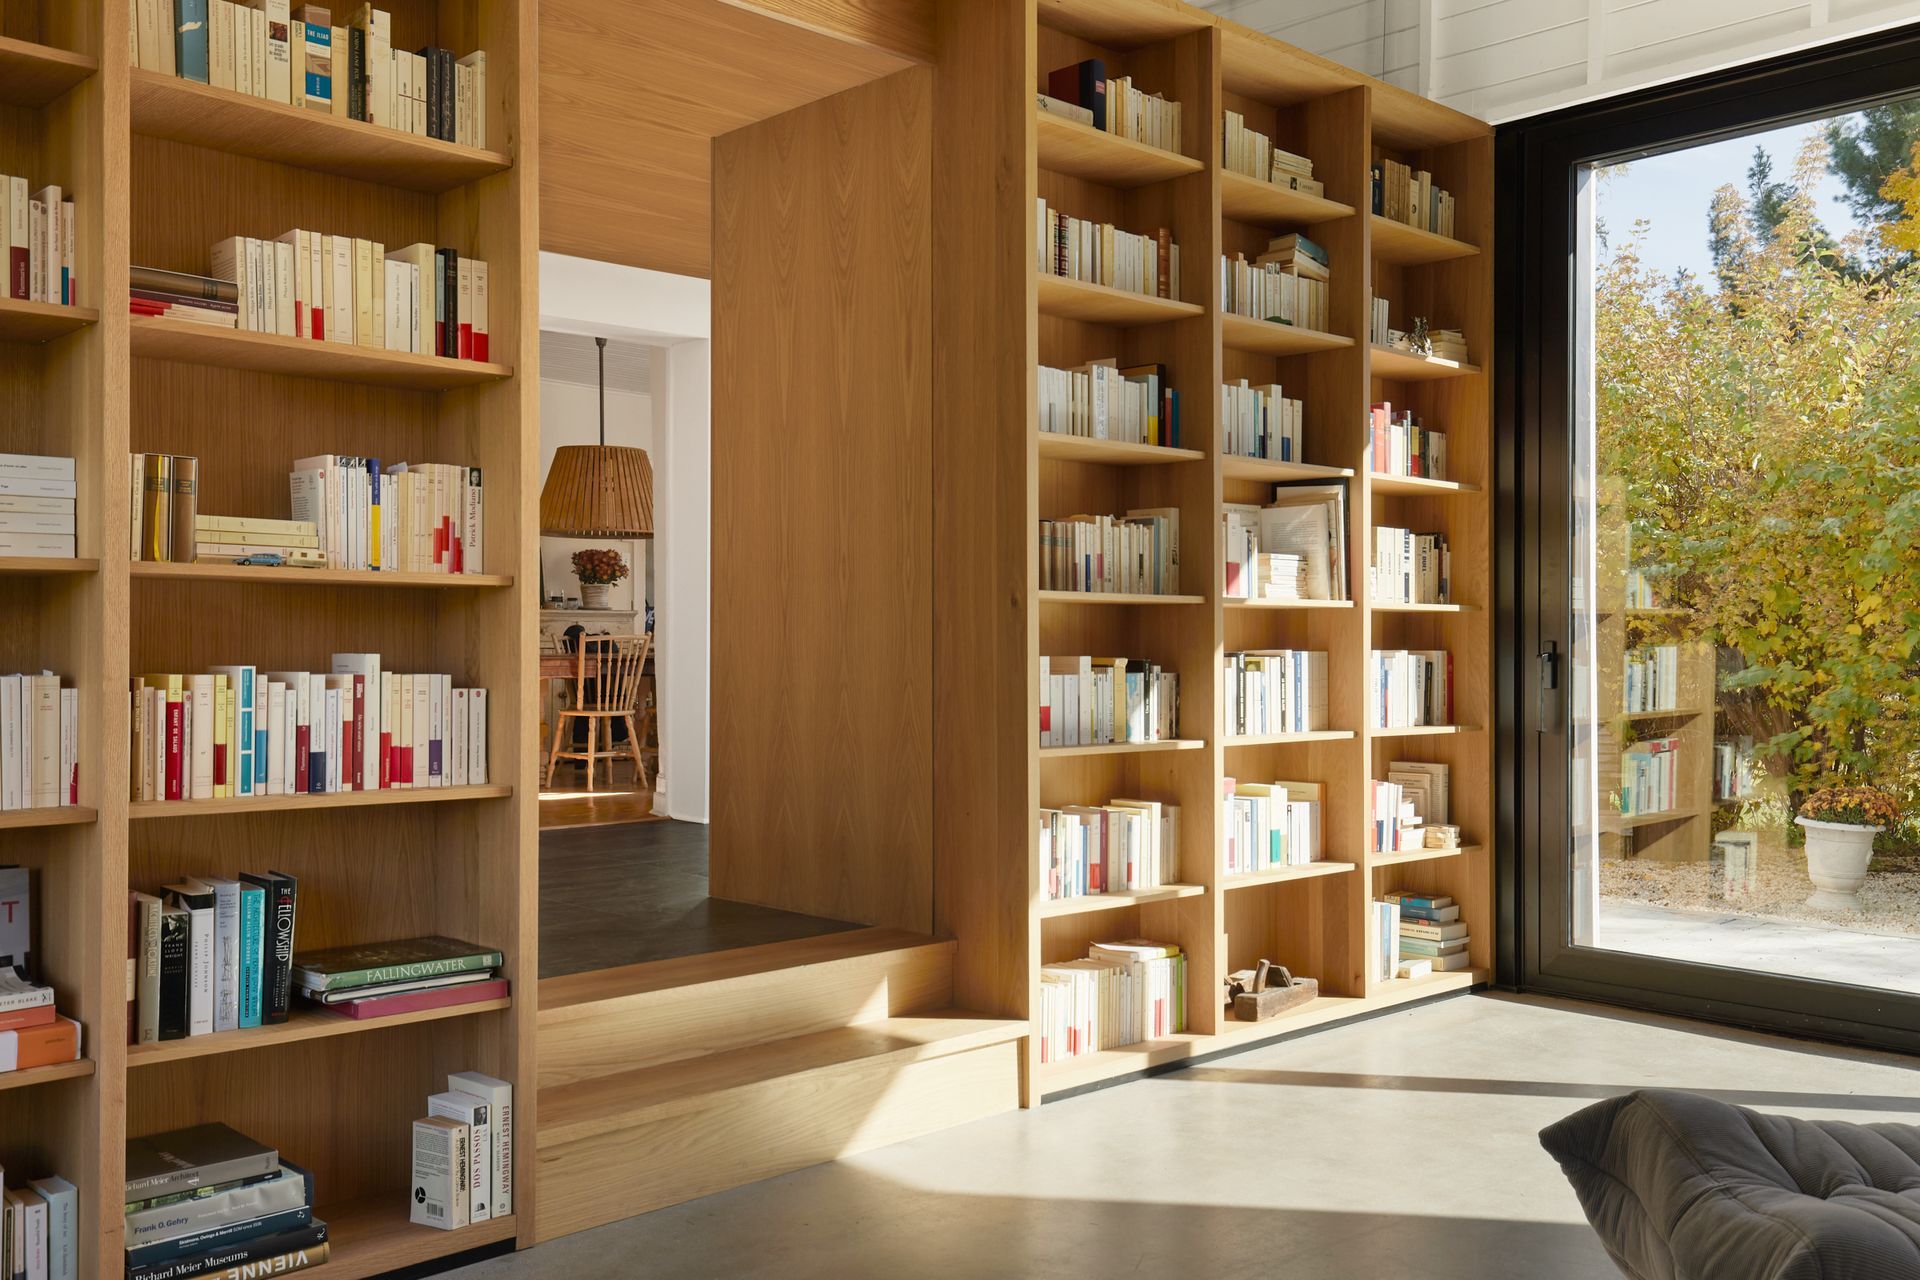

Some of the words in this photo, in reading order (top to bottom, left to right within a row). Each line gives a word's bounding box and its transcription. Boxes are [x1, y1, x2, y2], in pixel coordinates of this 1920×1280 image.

[307, 29, 315, 37] THE
[316, 31, 329, 41] ILIAD
[468, 488, 476, 520] Modiano
[468, 523, 476, 547] Patrick
[366, 960, 466, 982] FALLINGWATER
[151, 1177, 168, 1185] Meier
[473, 1168, 481, 1188] DOS
[134, 1224, 156, 1234] Frank
[158, 1221, 165, 1229] O.
[166, 1217, 188, 1226] Gehry
[136, 1267, 173, 1280] Richard
[176, 1261, 202, 1275] Meier
[204, 1249, 249, 1269] Museums
[230, 1250, 308, 1280] VIENNE
